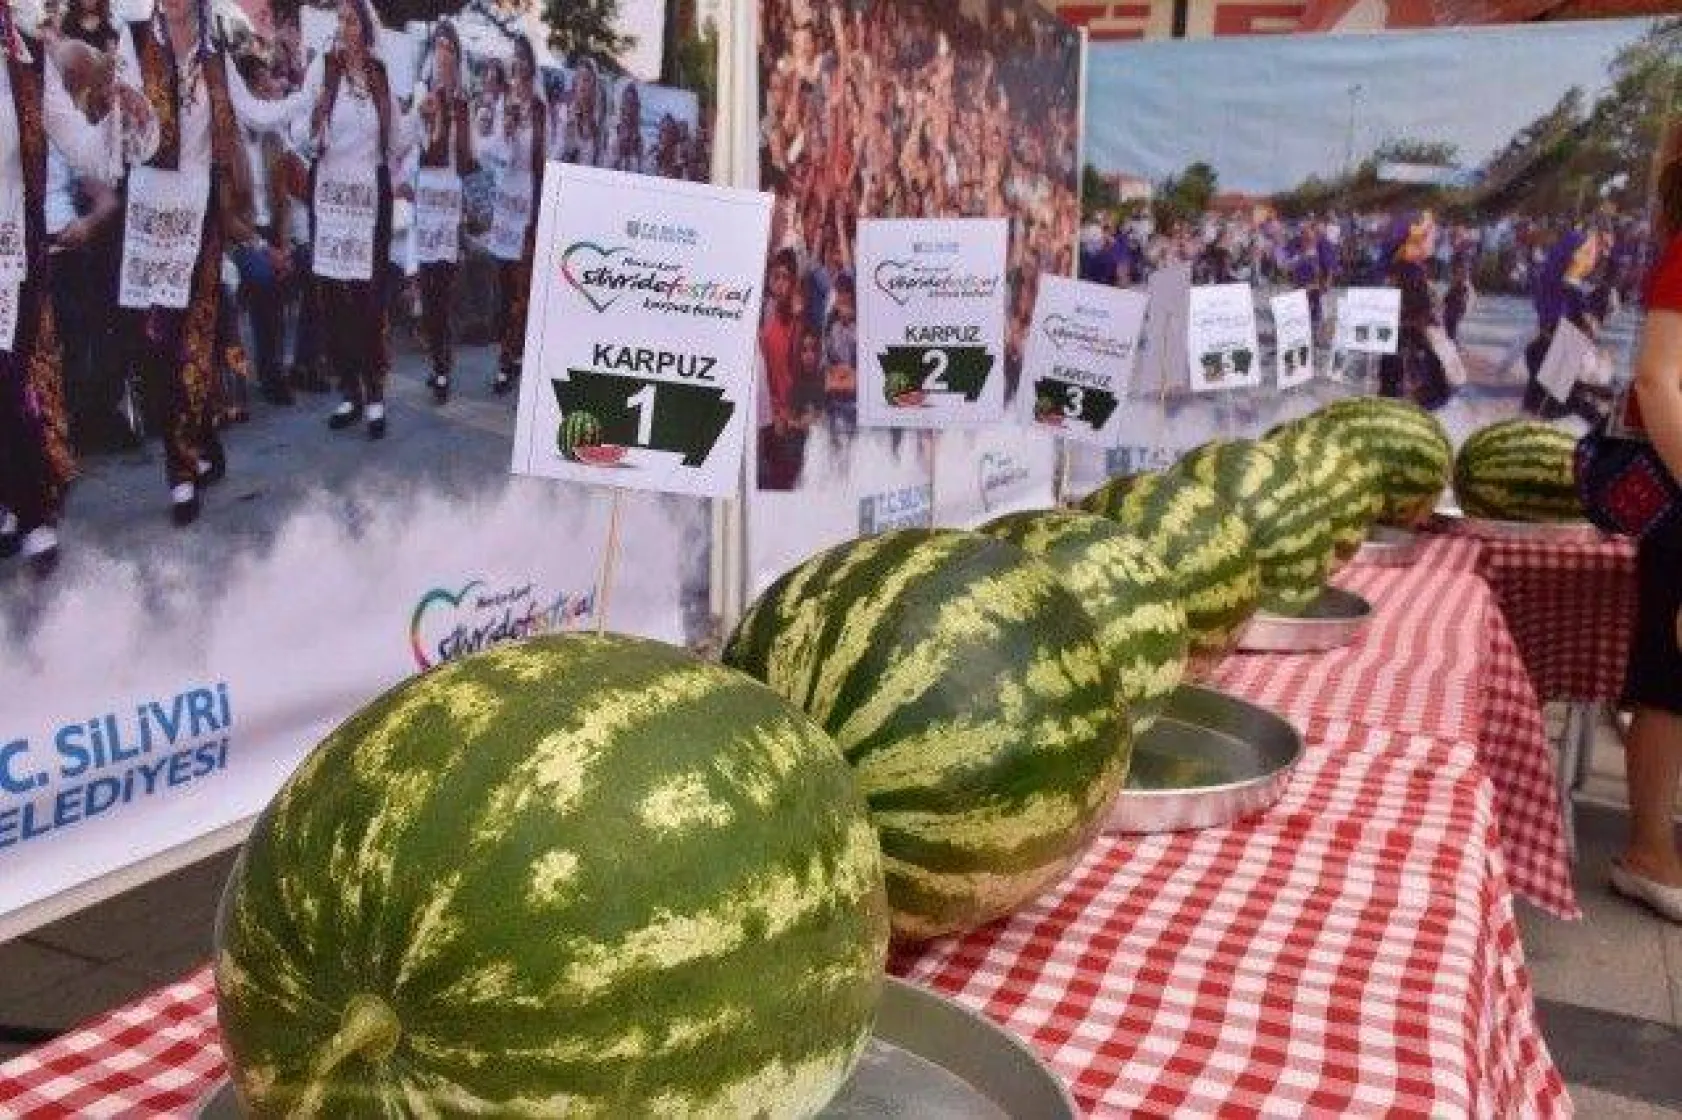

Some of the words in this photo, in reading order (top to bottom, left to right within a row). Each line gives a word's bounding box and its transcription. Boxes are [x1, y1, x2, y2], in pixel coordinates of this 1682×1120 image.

[905, 325, 980, 342] KARPUZ
[592, 343, 718, 382] KARPUZ
[921, 349, 949, 390] 2
[626, 382, 657, 446] 1
[1063, 385, 1084, 417] 3
